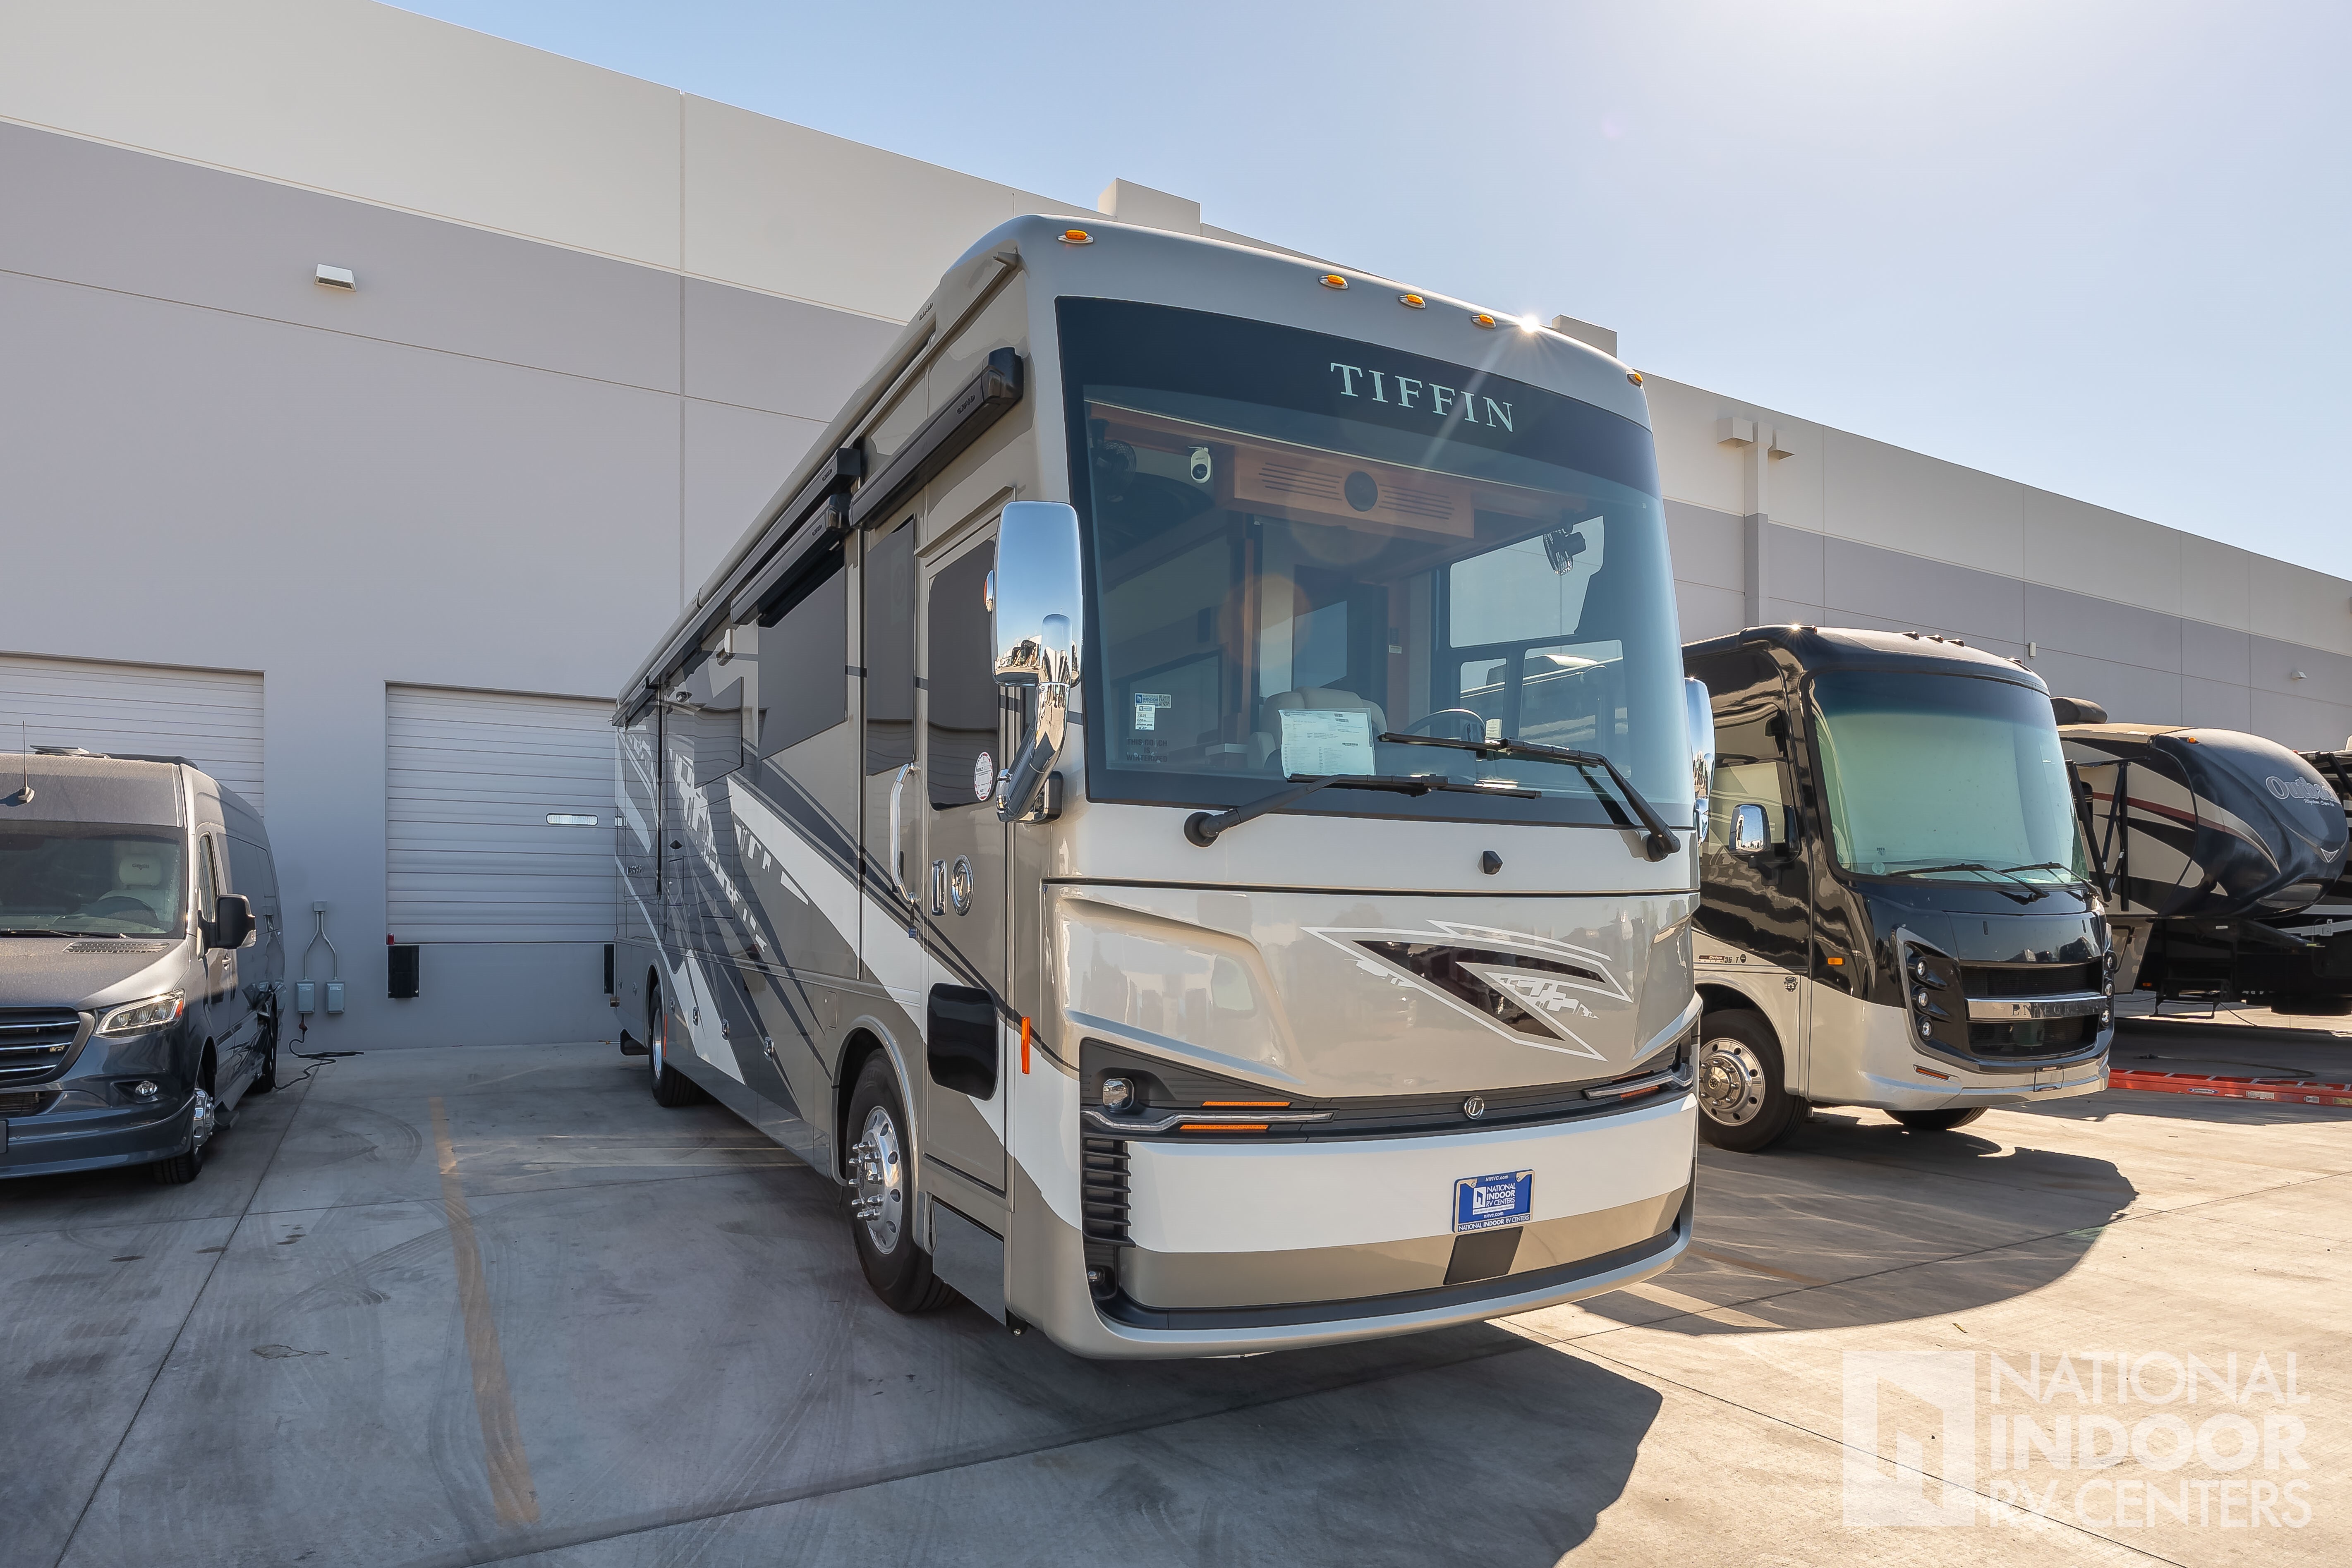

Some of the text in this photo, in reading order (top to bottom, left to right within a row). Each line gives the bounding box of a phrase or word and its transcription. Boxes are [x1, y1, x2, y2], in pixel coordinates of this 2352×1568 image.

[1330, 362, 1514, 432] TIFFIN
[1487, 1182, 1516, 1193] NATIONAL
[1486, 1190, 1515, 1200] INDOOR
[1494, 1197, 1515, 1206] CENTERS
[1483, 1219, 1504, 1228] INDOOR
[1512, 1214, 1530, 1223] CENTERS
